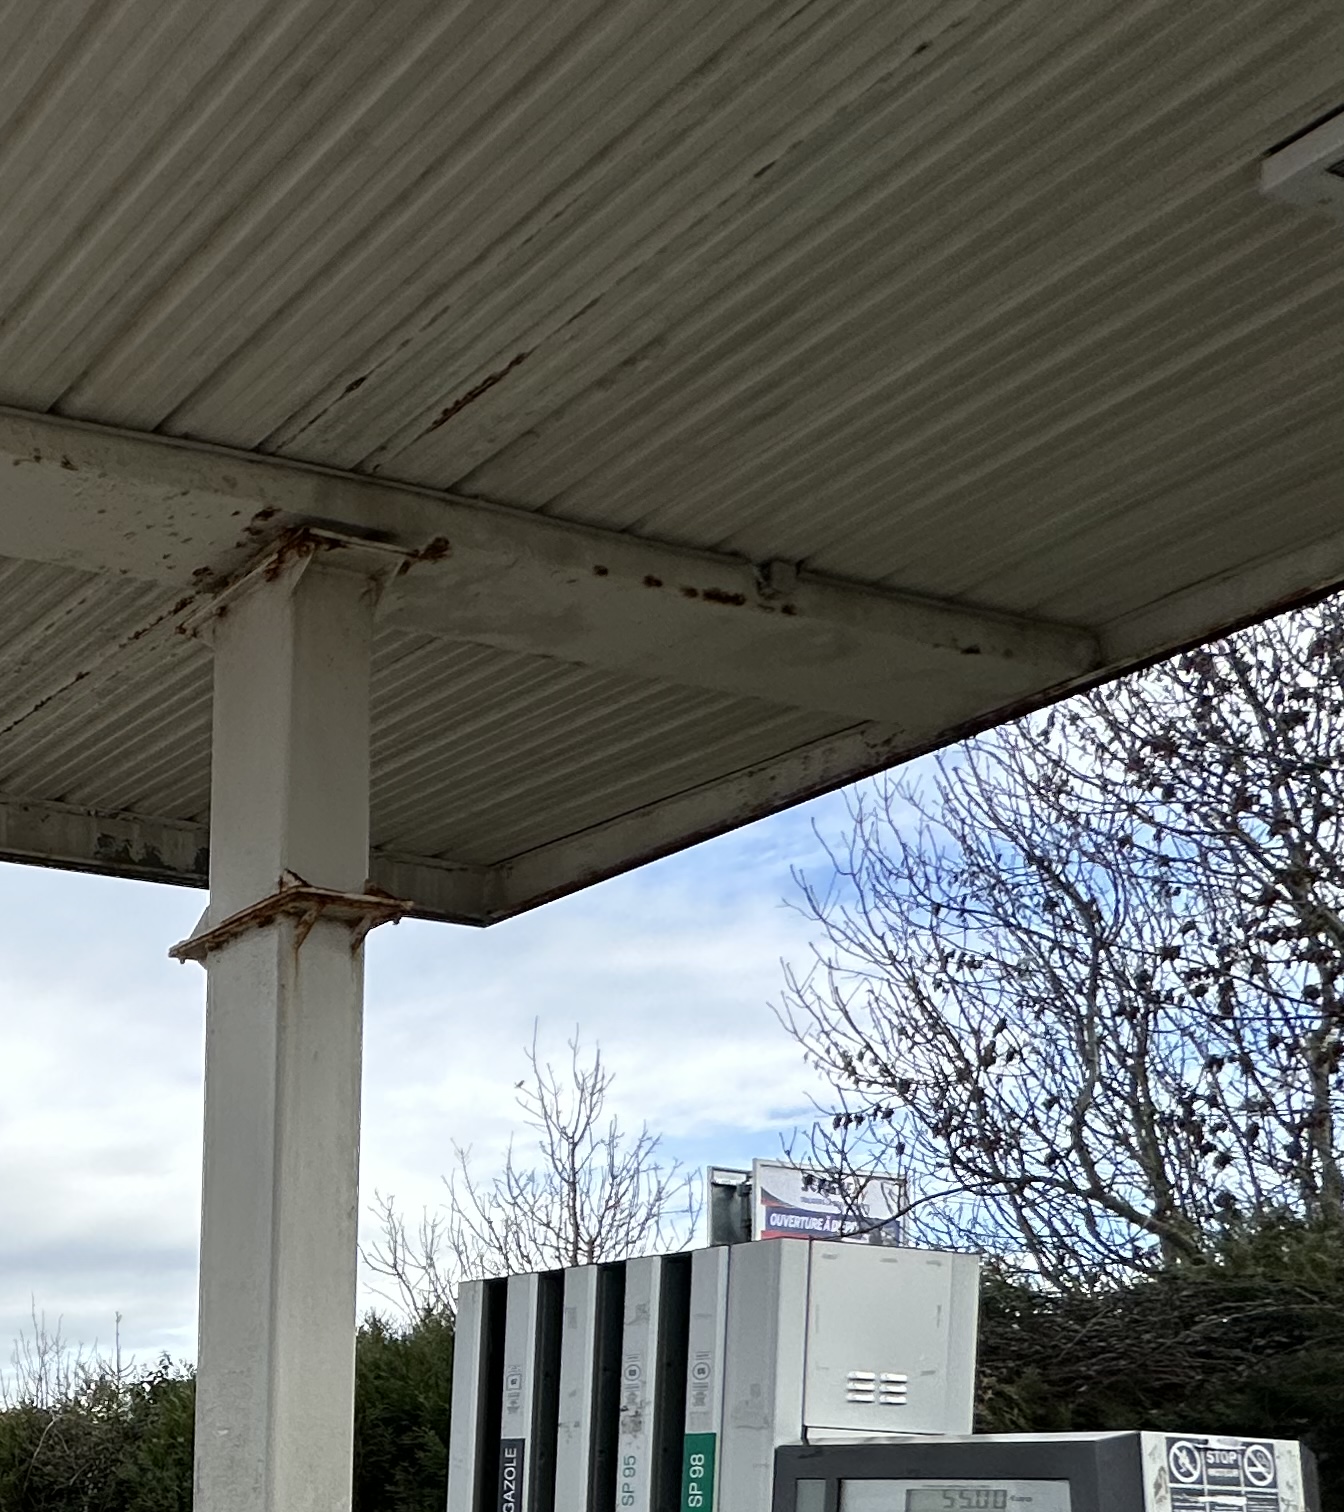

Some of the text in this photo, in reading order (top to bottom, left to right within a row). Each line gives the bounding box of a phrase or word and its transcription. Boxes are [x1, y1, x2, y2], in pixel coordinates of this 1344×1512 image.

[770, 1213, 824, 1230] OUVERTURE
[822, 1215, 832, 1231] À
[1206, 1451, 1237, 1464] STOP
[622, 1455, 636, 1507] SP 95
[688, 1453, 705, 1508] SP 98
